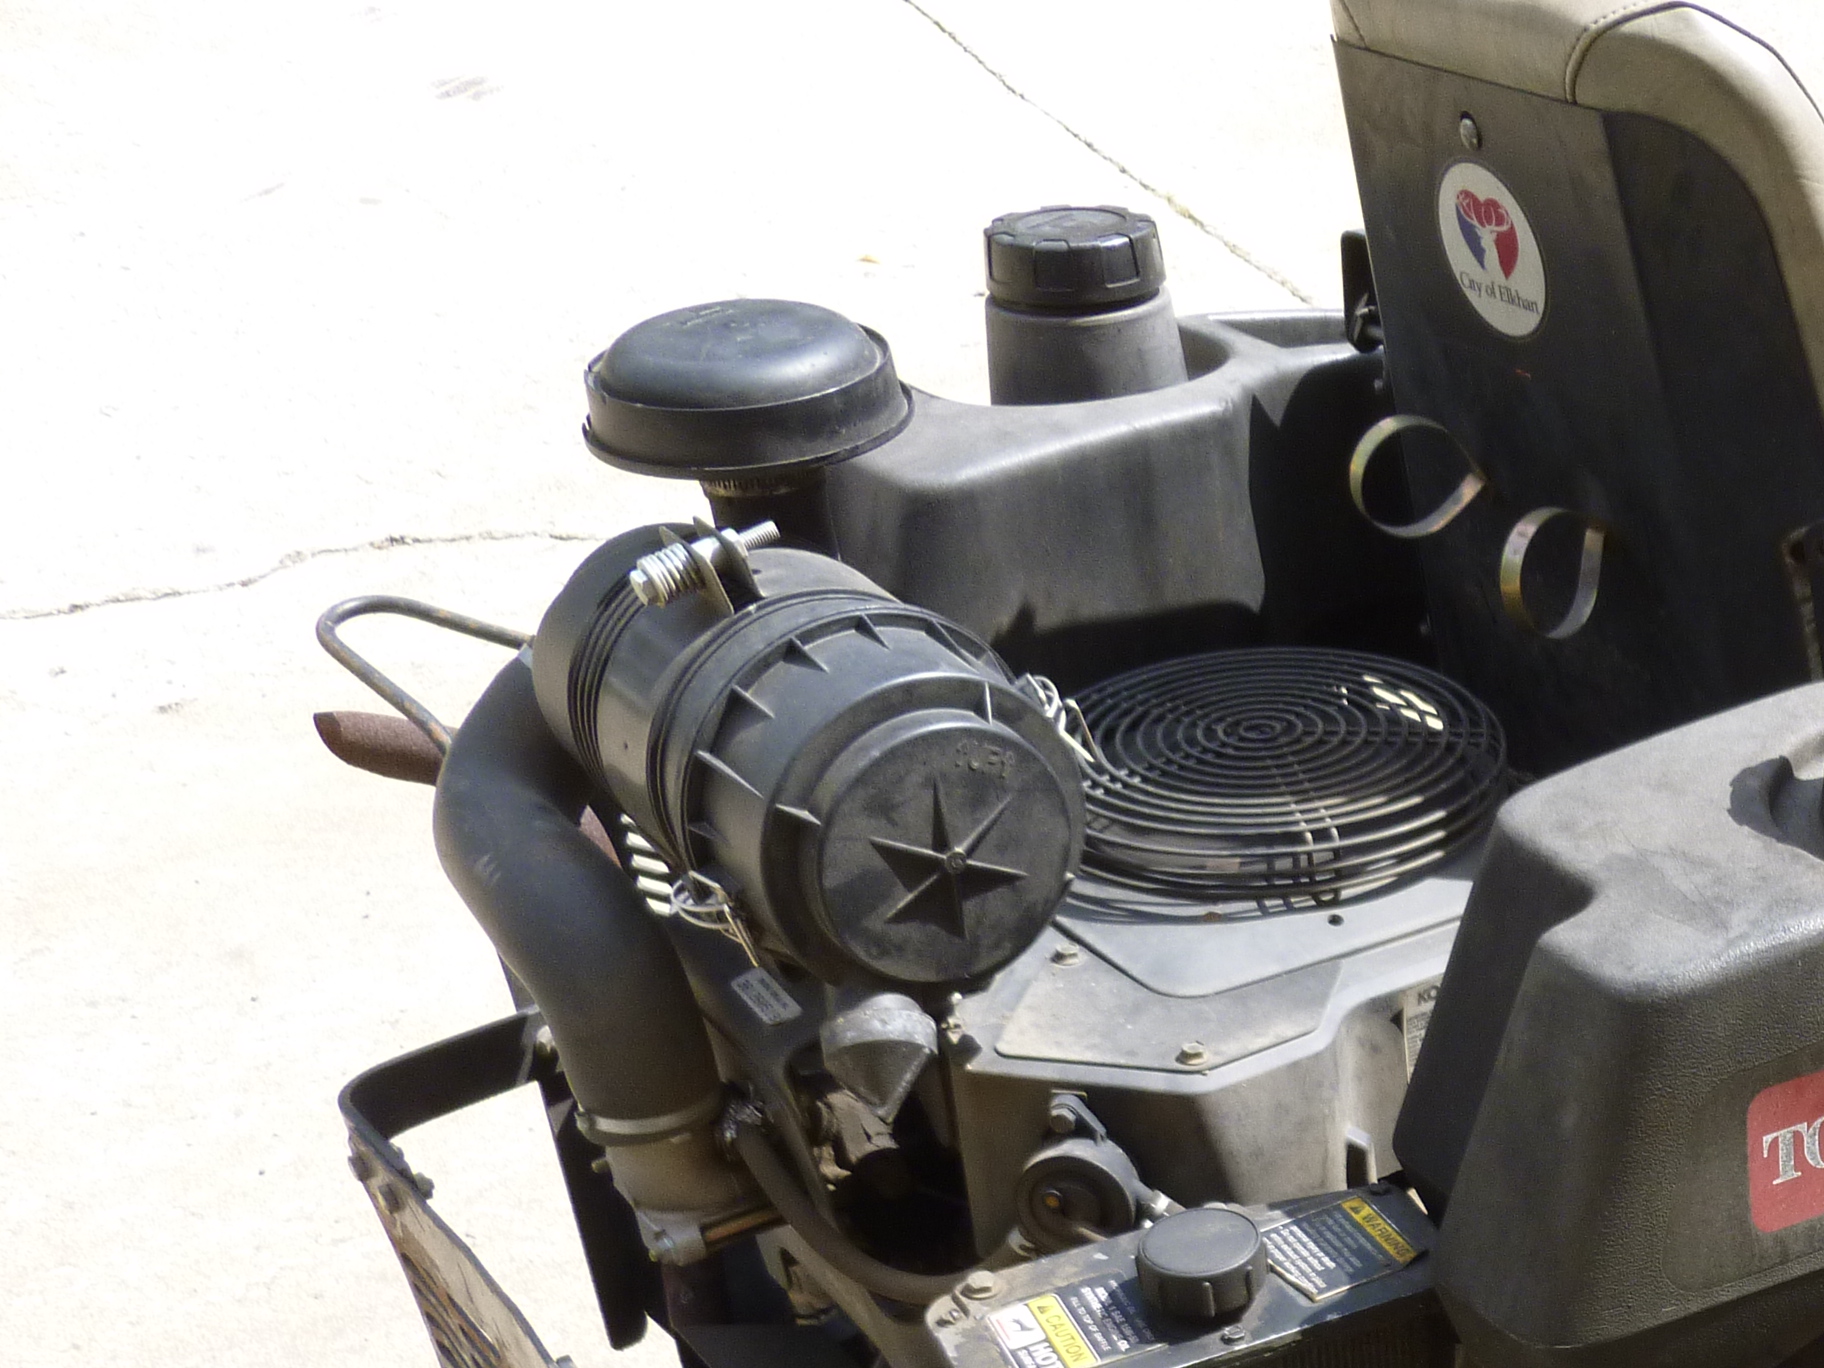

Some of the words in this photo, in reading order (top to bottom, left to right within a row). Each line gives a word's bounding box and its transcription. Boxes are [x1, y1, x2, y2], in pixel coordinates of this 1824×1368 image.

[1459, 271, 1483, 296] City
[1484, 281, 1496, 299] of
[1498, 285, 1540, 315] Elkhart
[1044, 1314, 1087, 1363] CAUTION
